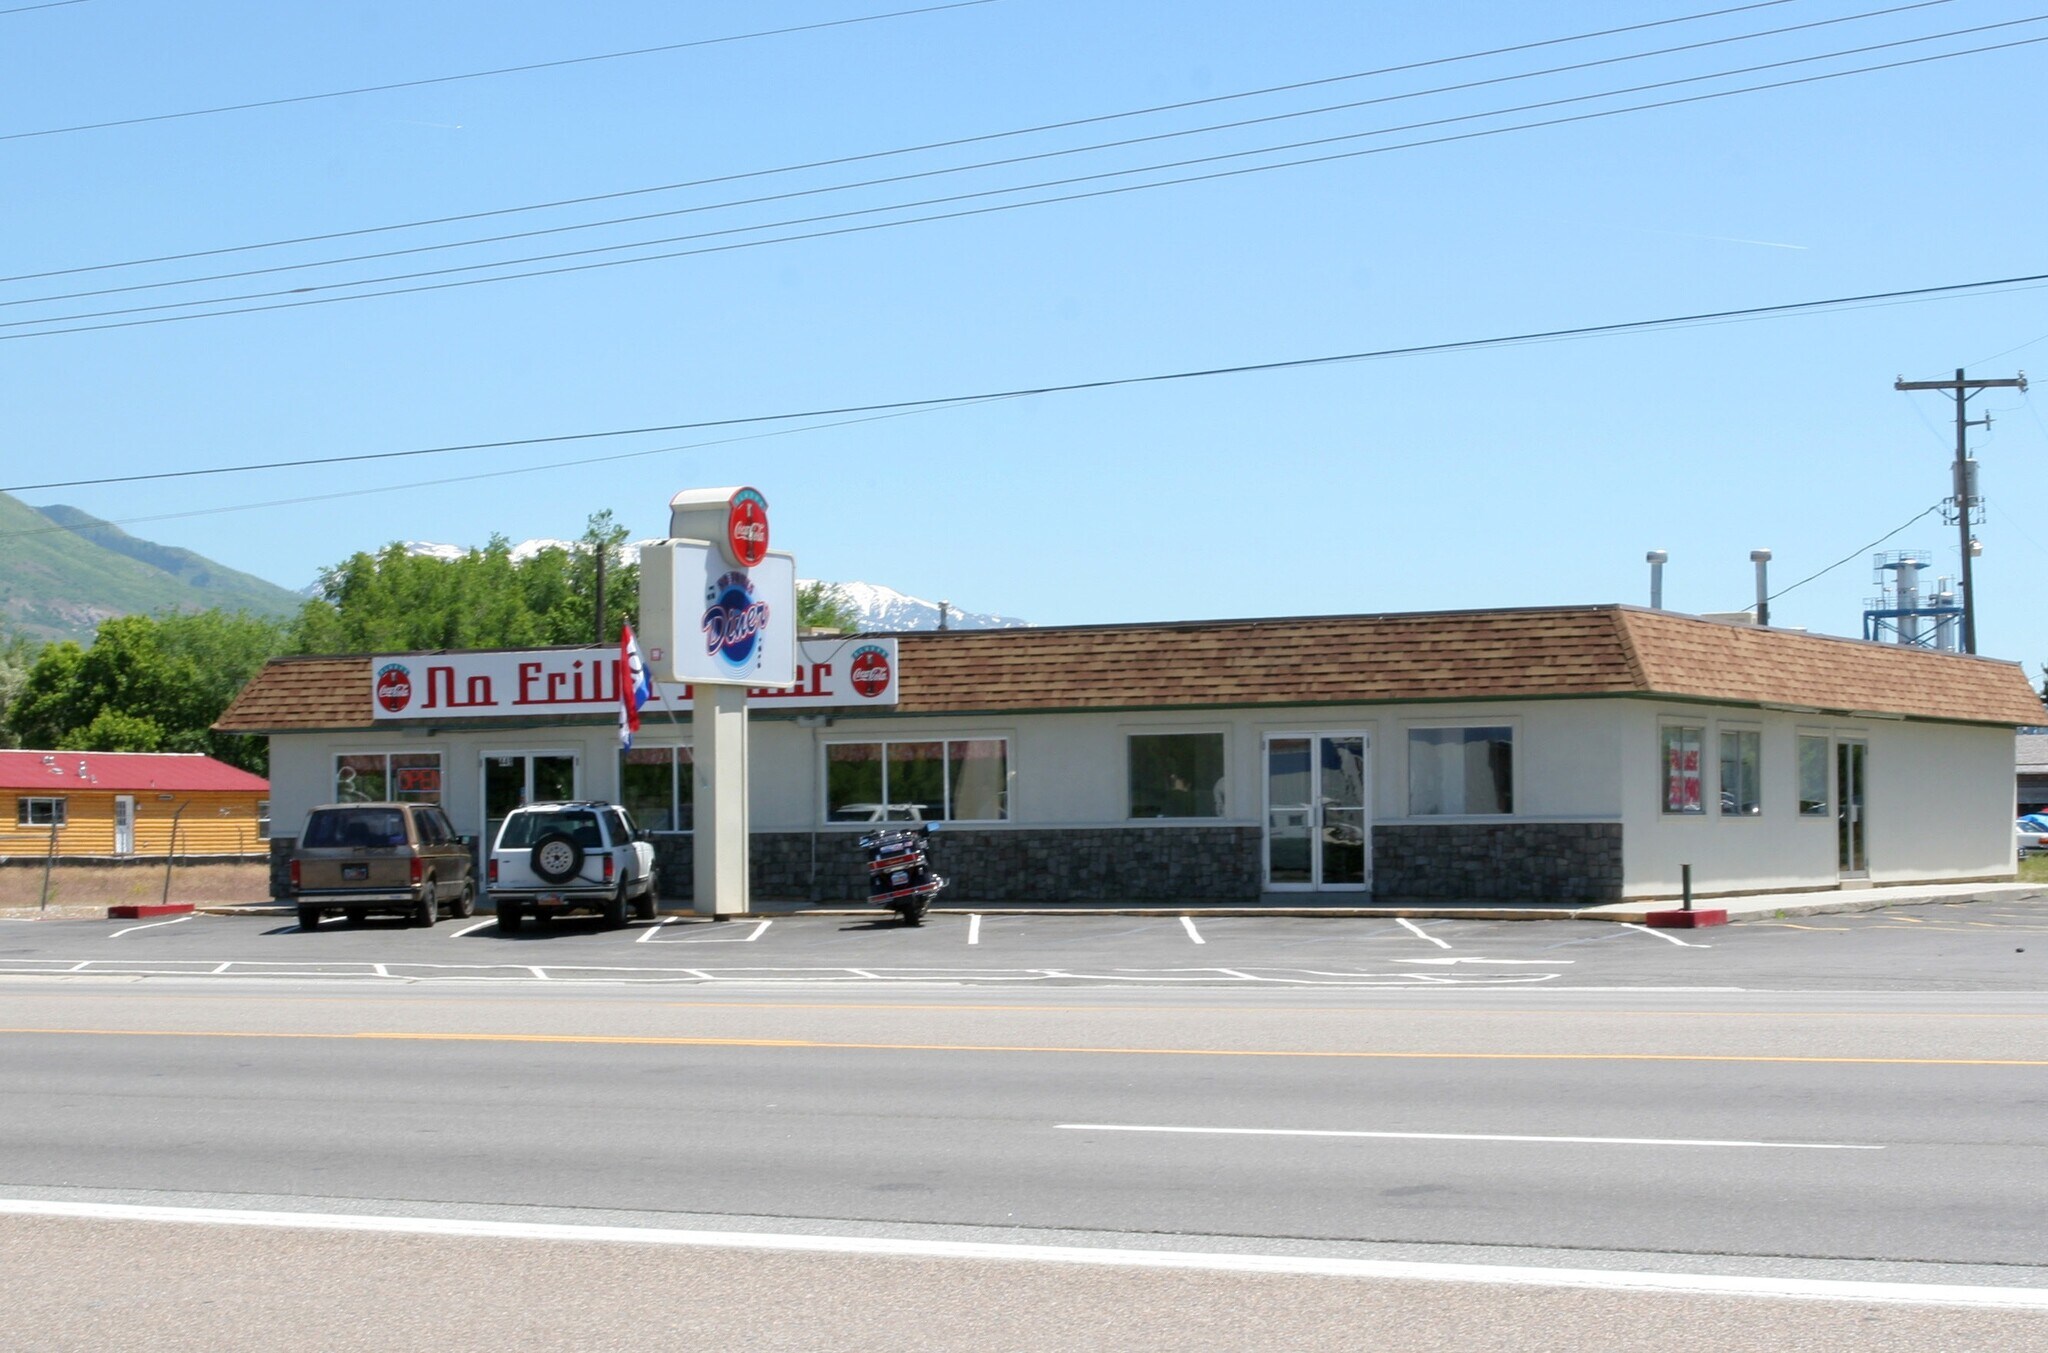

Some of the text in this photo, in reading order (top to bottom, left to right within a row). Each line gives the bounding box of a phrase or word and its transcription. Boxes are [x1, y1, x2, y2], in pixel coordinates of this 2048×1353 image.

[701, 602, 769, 656] Diner
[421, 667, 498, 708] No
[512, 660, 660, 705] Frill
[852, 667, 888, 682] Coca-Cola
[400, 769, 441, 790] OPEN
